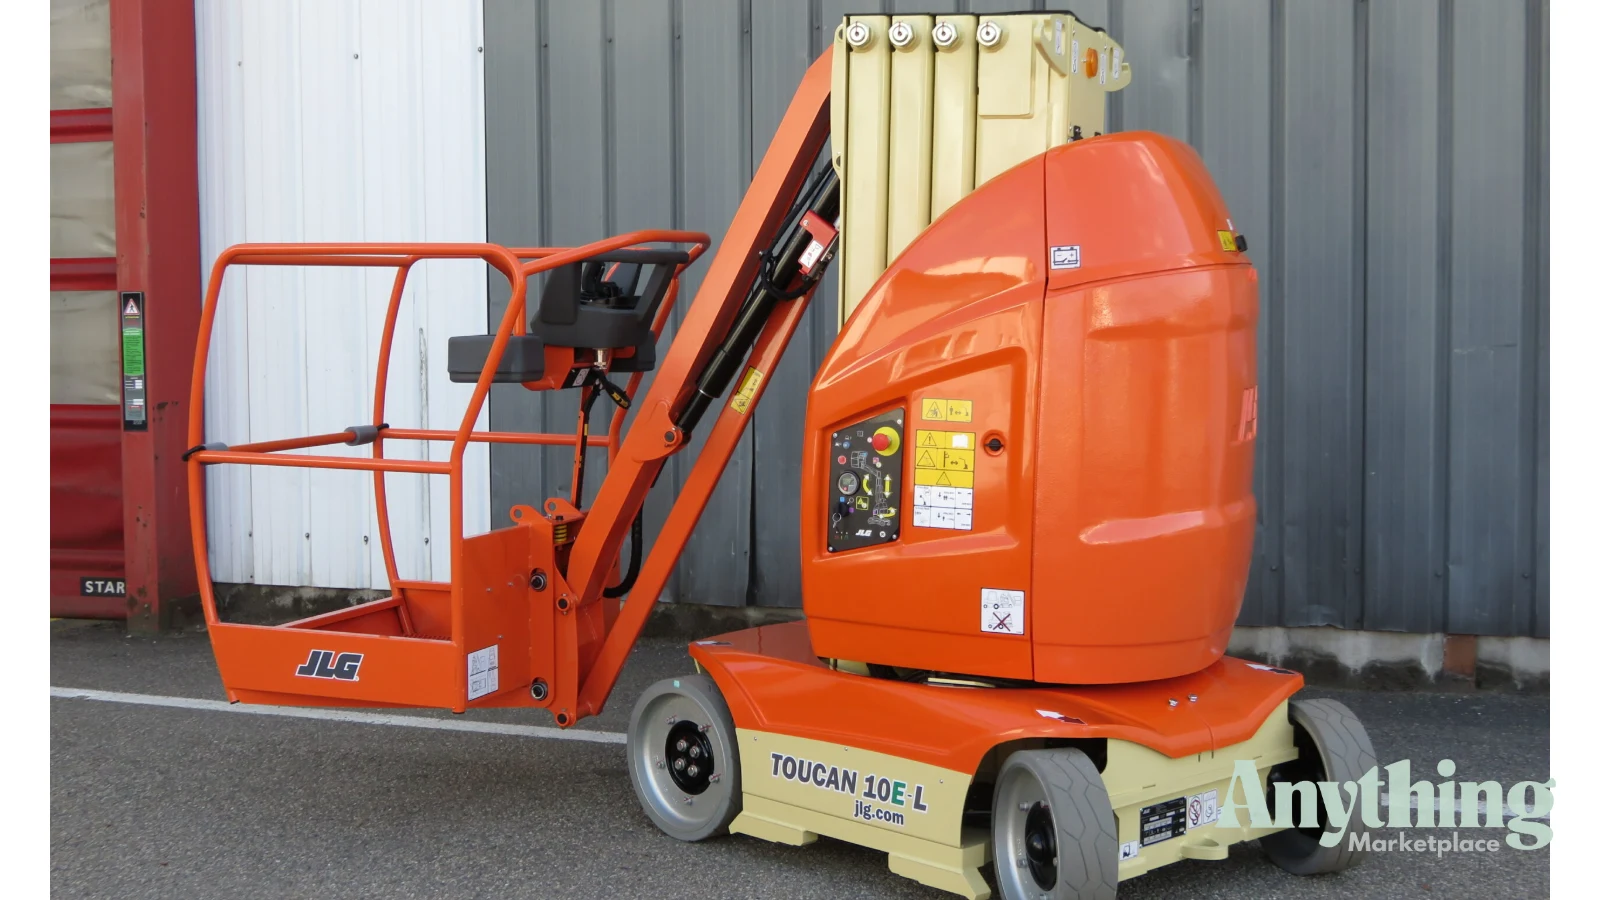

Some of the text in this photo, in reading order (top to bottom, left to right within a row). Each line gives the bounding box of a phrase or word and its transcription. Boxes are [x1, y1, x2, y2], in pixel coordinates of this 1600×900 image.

[855, 529, 872, 537] JLG
[85, 580, 125, 594] STAR
[295, 649, 364, 681] JLG
[771, 753, 927, 811] TOUCAN 10E-L
[854, 800, 904, 825] jlg.com
